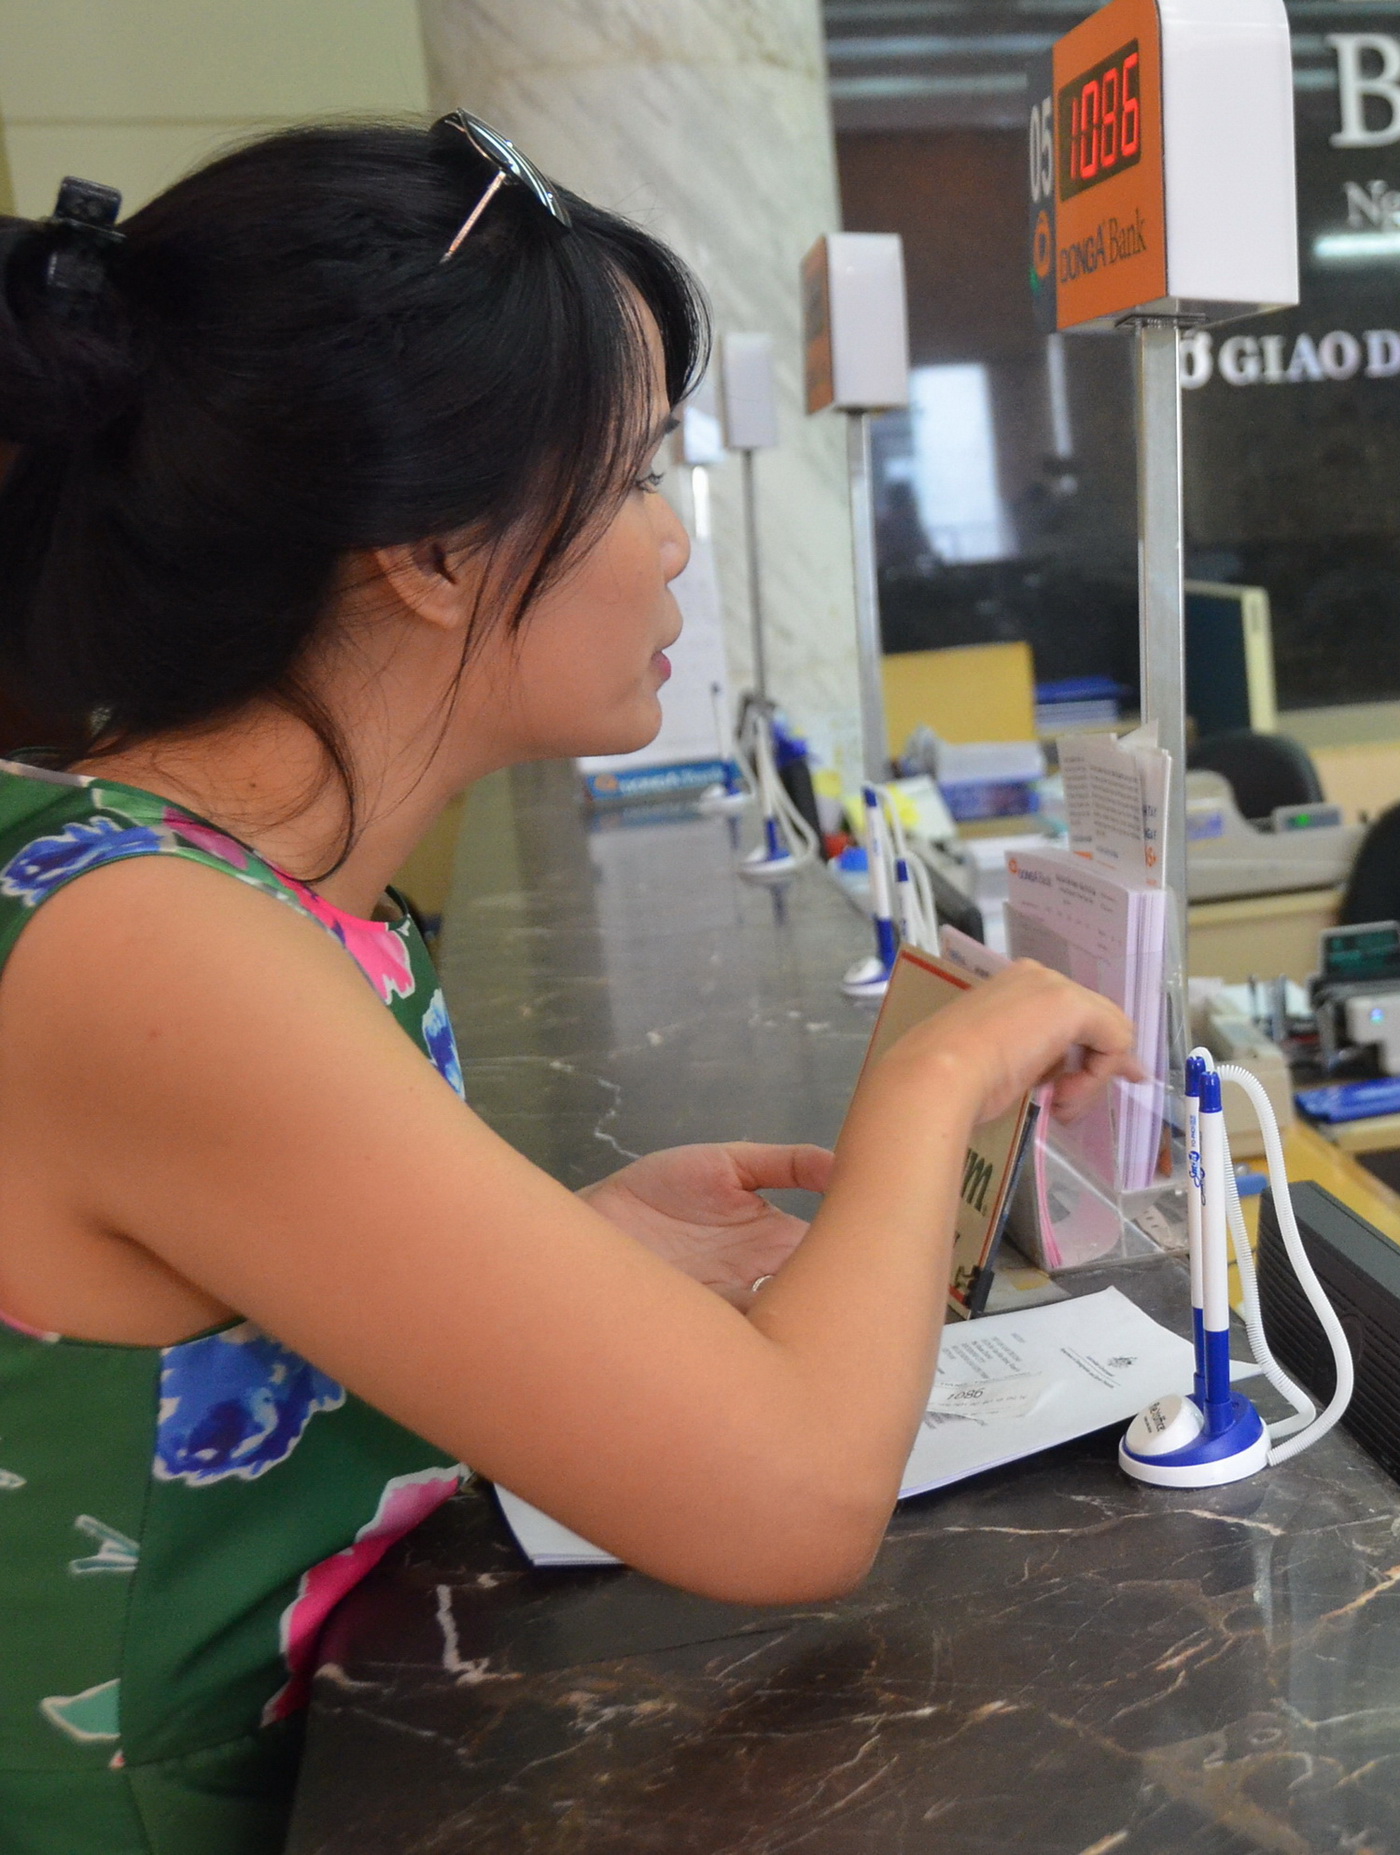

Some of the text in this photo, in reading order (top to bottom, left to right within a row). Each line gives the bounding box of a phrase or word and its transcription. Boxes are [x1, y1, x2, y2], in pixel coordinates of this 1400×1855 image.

[1029, 96, 1052, 203] 05
[1070, 52, 1139, 181] 1086
[1108, 207, 1147, 265] Bank
[1218, 329, 1361, 386] GIAO
